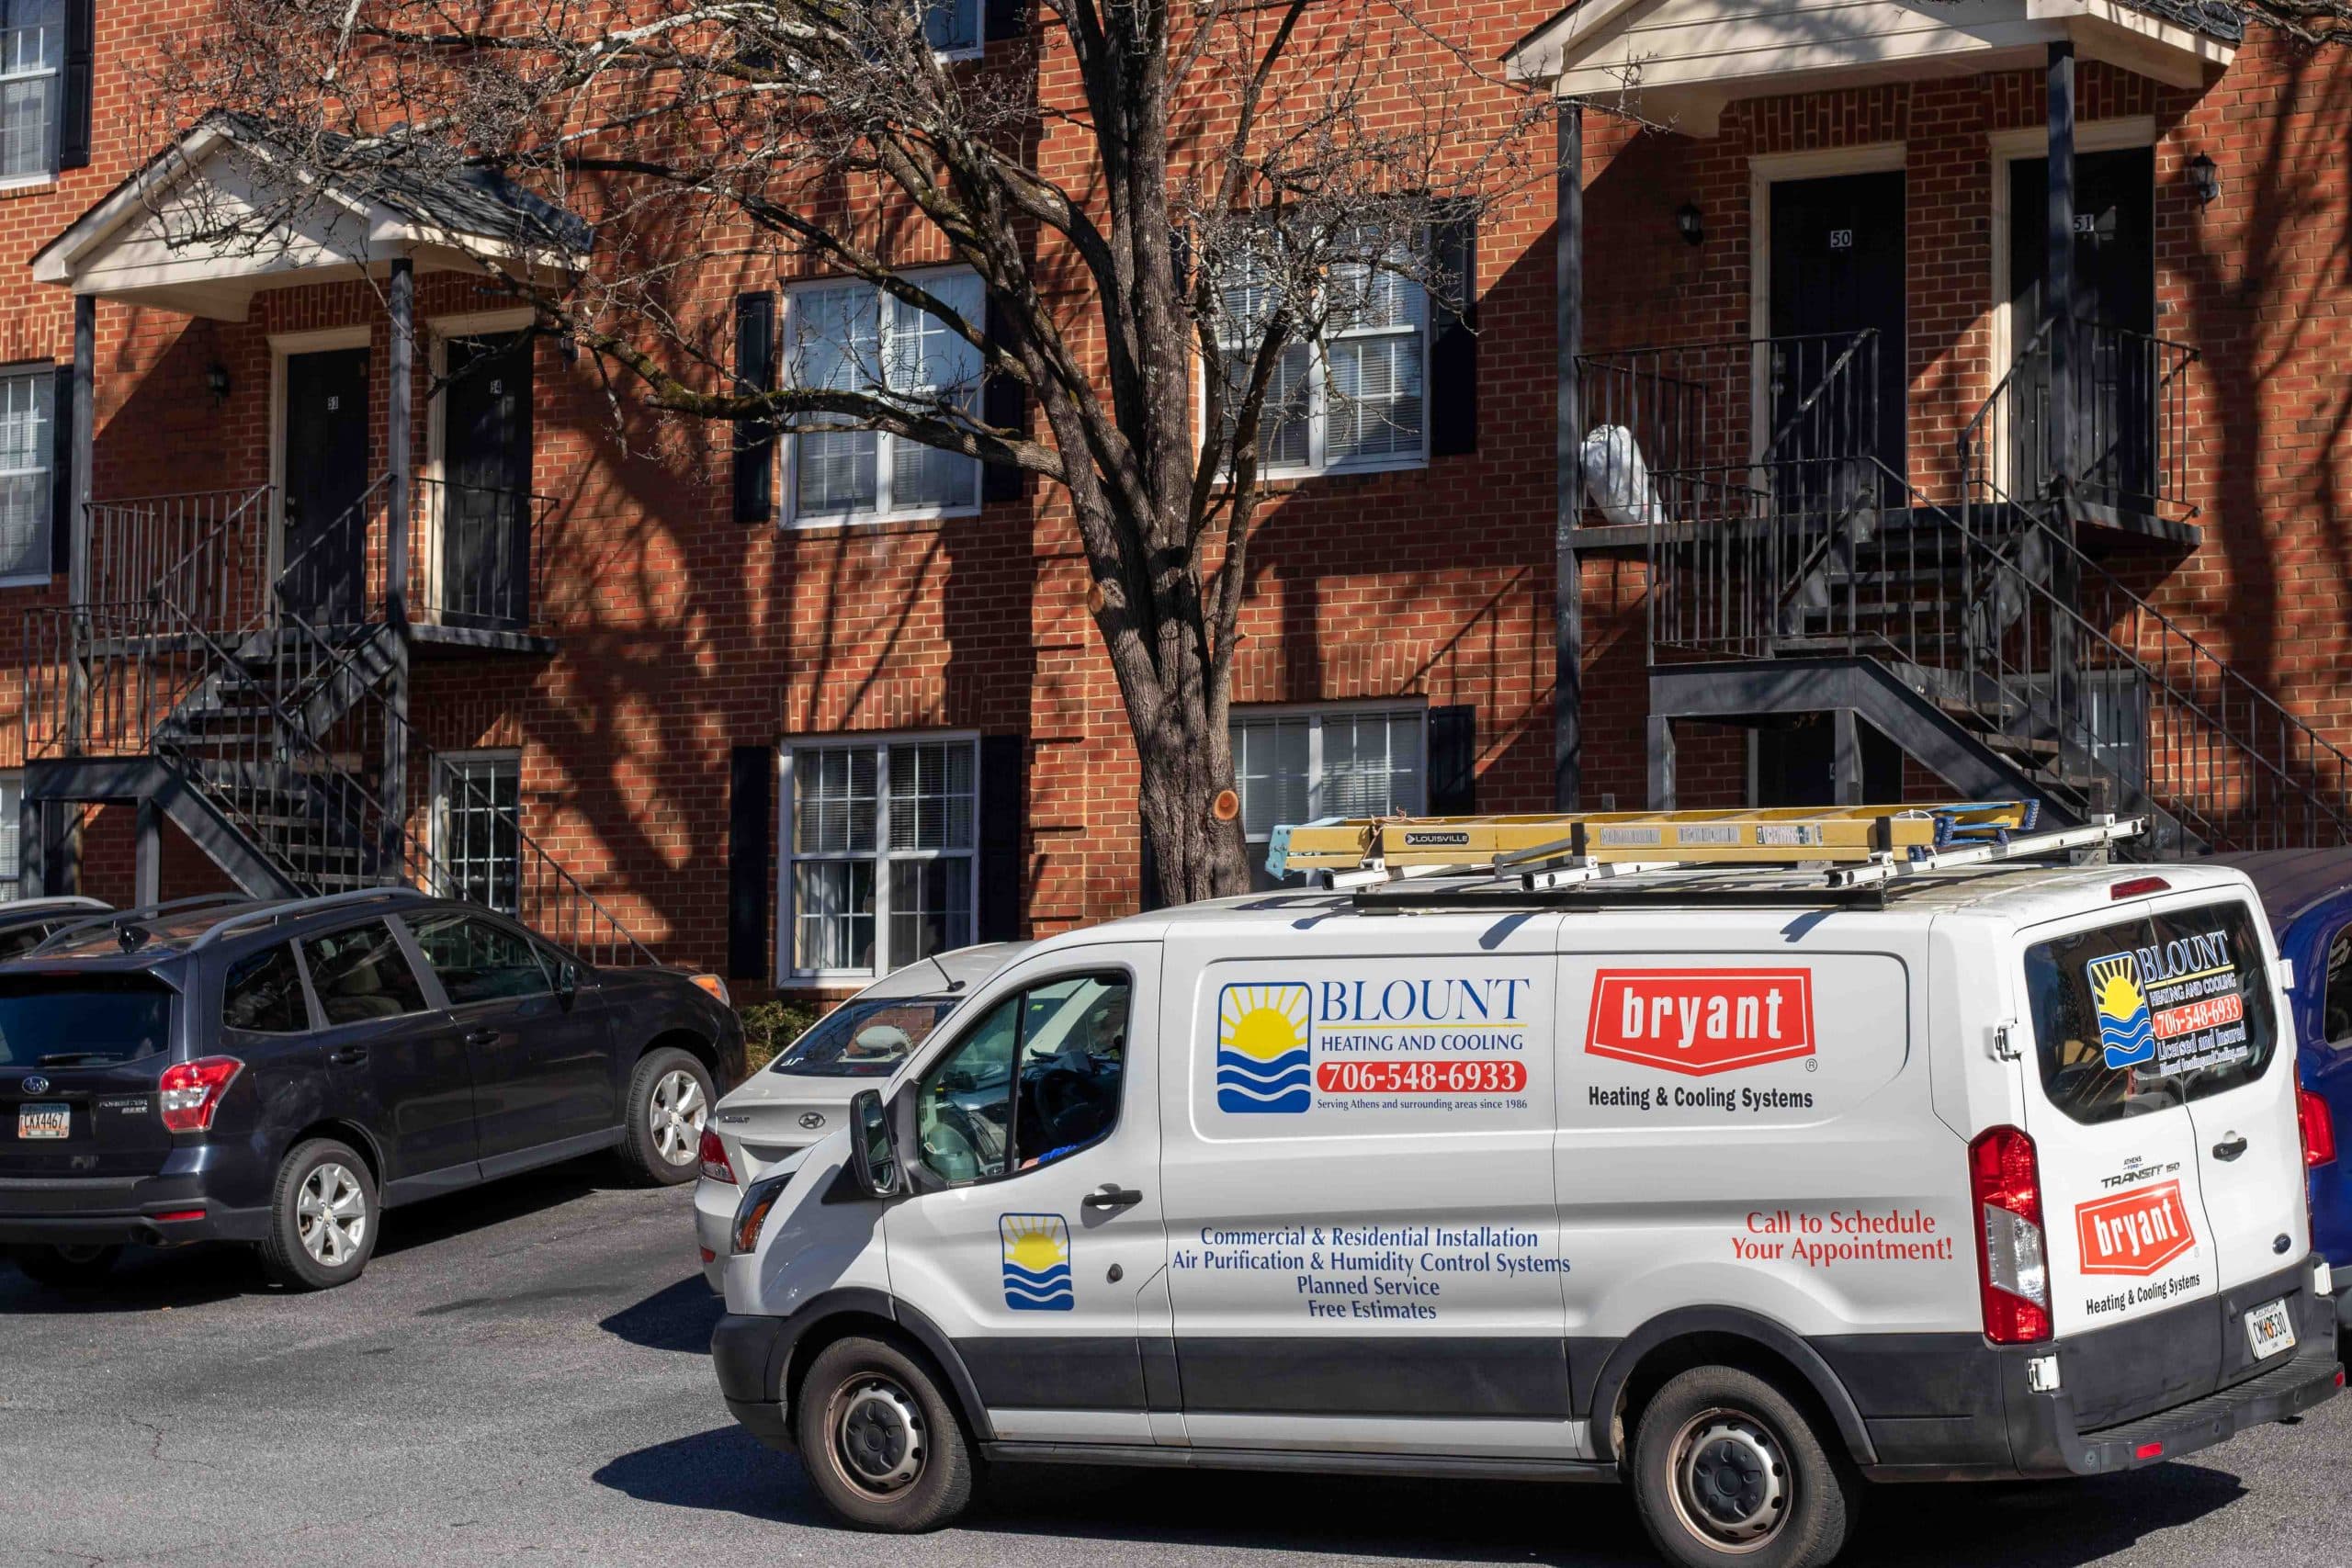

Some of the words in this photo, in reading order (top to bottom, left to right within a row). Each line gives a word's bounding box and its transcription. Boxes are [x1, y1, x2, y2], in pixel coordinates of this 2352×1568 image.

[2073, 215, 2091, 231] 51
[1832, 231, 1850, 246] 50
[1415, 834, 1468, 842] LOUISVILLE
[2136, 930, 2232, 983] BLOUNT
[1317, 977, 1530, 1021] BLOUNT
[2150, 985, 2185, 1007] HEATING
[2185, 981, 2203, 998] AND
[2204, 974, 2237, 994] COOLING
[1621, 987, 1783, 1049] bryant
[2157, 998, 2239, 1036] 706-548-6933
[1321, 1035, 1394, 1052] HEATING
[1398, 1035, 1436, 1052] AND
[1441, 1033, 1523, 1052] COOLING
[2156, 1033, 2197, 1061] Licensed
[2198, 1032, 2215, 1049] and
[2215, 1021, 2247, 1044] Insured
[1325, 1062, 1517, 1091] 706-548-6933
[1317, 1099, 1349, 1111] Serving
[1351, 1099, 1380, 1110] Athens
[1382, 1099, 1398, 1110] and
[1400, 1099, 1453, 1111] surrounding
[1454, 1100, 1478, 1110] areas
[1479, 1100, 1503, 1110] since
[1505, 1100, 1528, 1110] 1986
[1589, 1086, 1651, 1111] Heating
[1656, 1087, 1668, 1107] &
[1674, 1087, 1736, 1111] Cooling
[1742, 1088, 1814, 1112] Systems
[24, 1112, 64, 1129] CKX4467
[2123, 1156, 2143, 1166] ATHENS
[2100, 1164, 2164, 1189] TRANSIT
[2165, 1162, 2180, 1173] 150
[1747, 1209, 1792, 1234] Call
[1799, 1212, 1823, 1234] to
[1829, 1209, 1936, 1234] Schedule
[2094, 1198, 2179, 1258] bryant
[1200, 1226, 1306, 1247] Commercial
[1311, 1229, 1326, 1247] &
[1331, 1226, 1429, 1247] Residential
[1436, 1226, 1539, 1247] Installation
[1172, 1250, 1199, 1269] Air
[1204, 1250, 1305, 1271] Purification
[1310, 1253, 1325, 1271] &
[1330, 1251, 1415, 1278] Humidity
[1420, 1252, 1490, 1273] Control
[1496, 1253, 1571, 1278] Systems
[1731, 1237, 1784, 1260] Your
[1791, 1235, 1953, 1268] Appointment!
[1296, 1275, 1369, 1296] Planned
[1374, 1276, 1441, 1296] Service
[2086, 1293, 2126, 1315] Heating
[2128, 1290, 2135, 1305] &
[2137, 1280, 2168, 1303] Cooling
[2168, 1273, 2200, 1296] Systems
[1307, 1299, 1347, 1318] Free
[1351, 1299, 1437, 1321] Estimates
